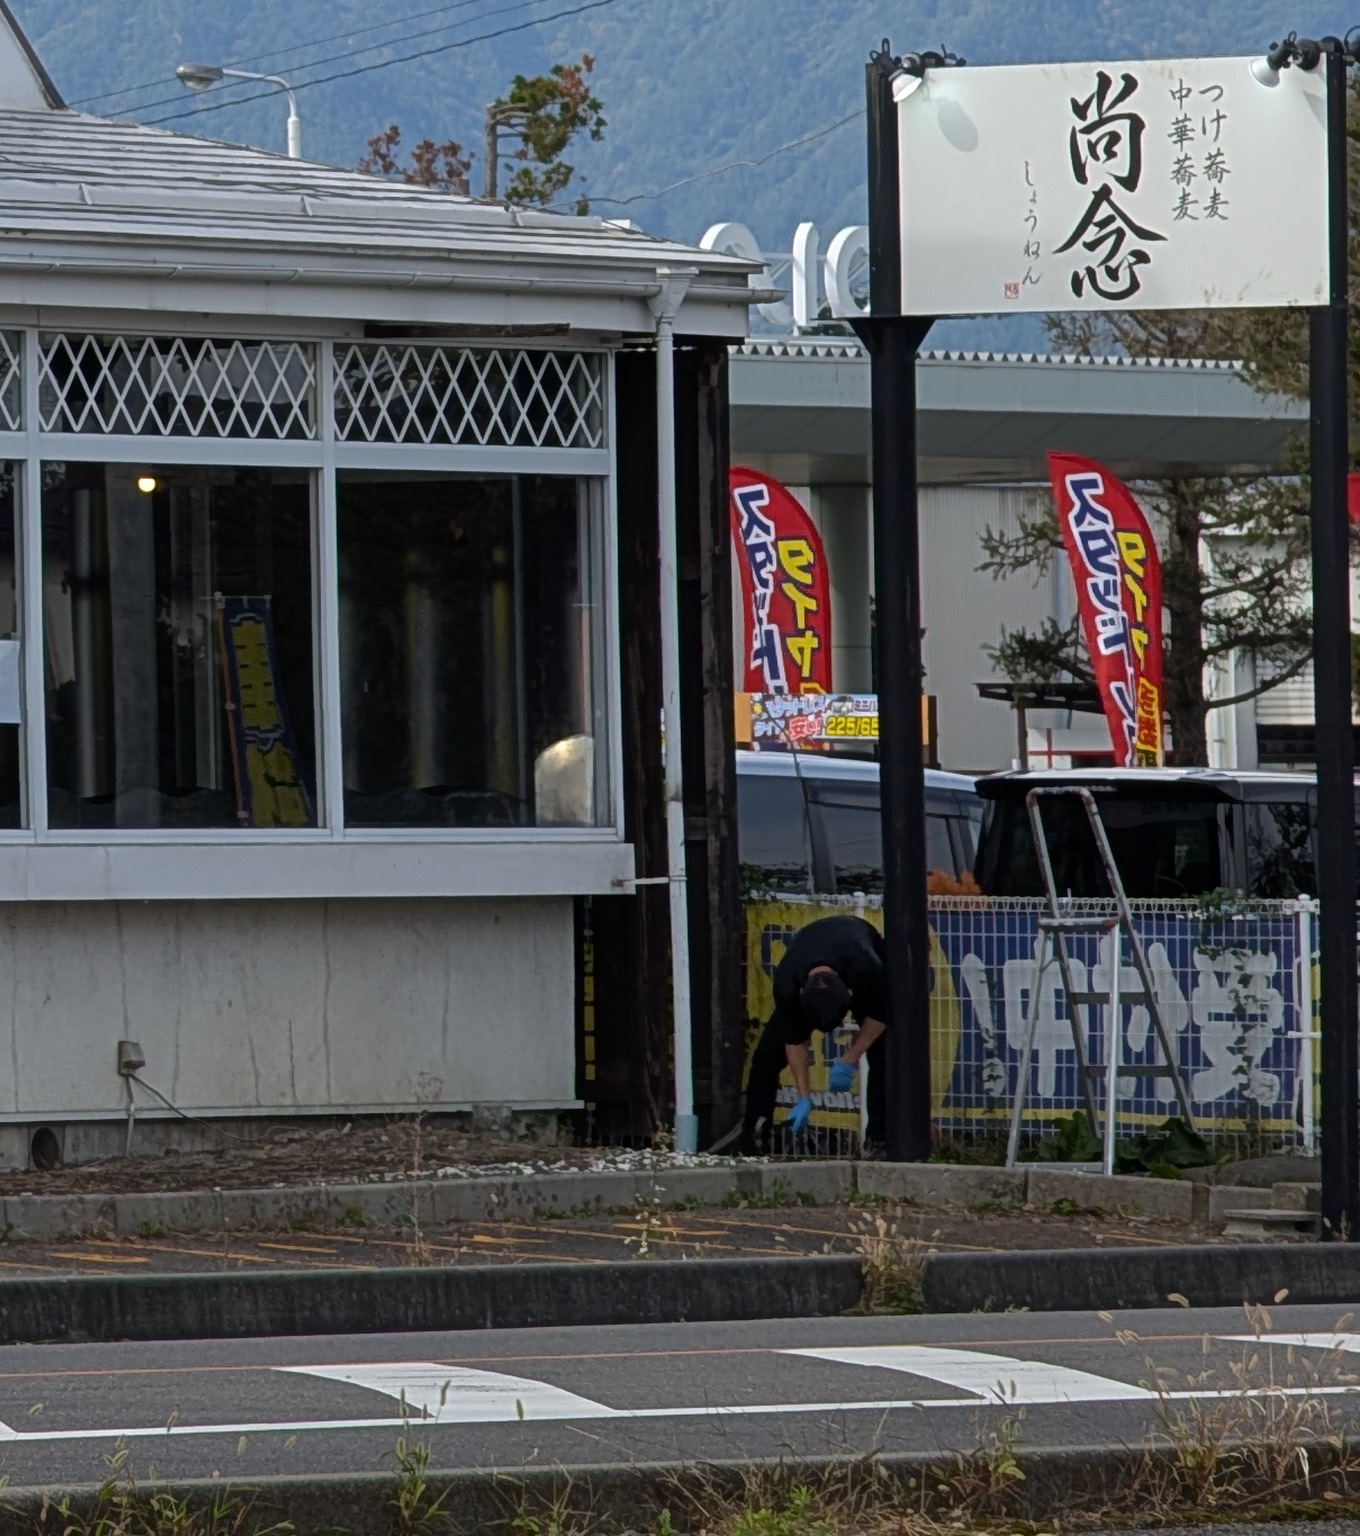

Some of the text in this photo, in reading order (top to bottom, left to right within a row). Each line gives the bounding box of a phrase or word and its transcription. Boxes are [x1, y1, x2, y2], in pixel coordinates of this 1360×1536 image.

[1052, 71, 1168, 300] 尚念
[1167, 78, 1198, 221] 中華蕎麦
[1199, 85, 1231, 220] つけ蕎麦
[1022, 161, 1042, 285] しょうねん
